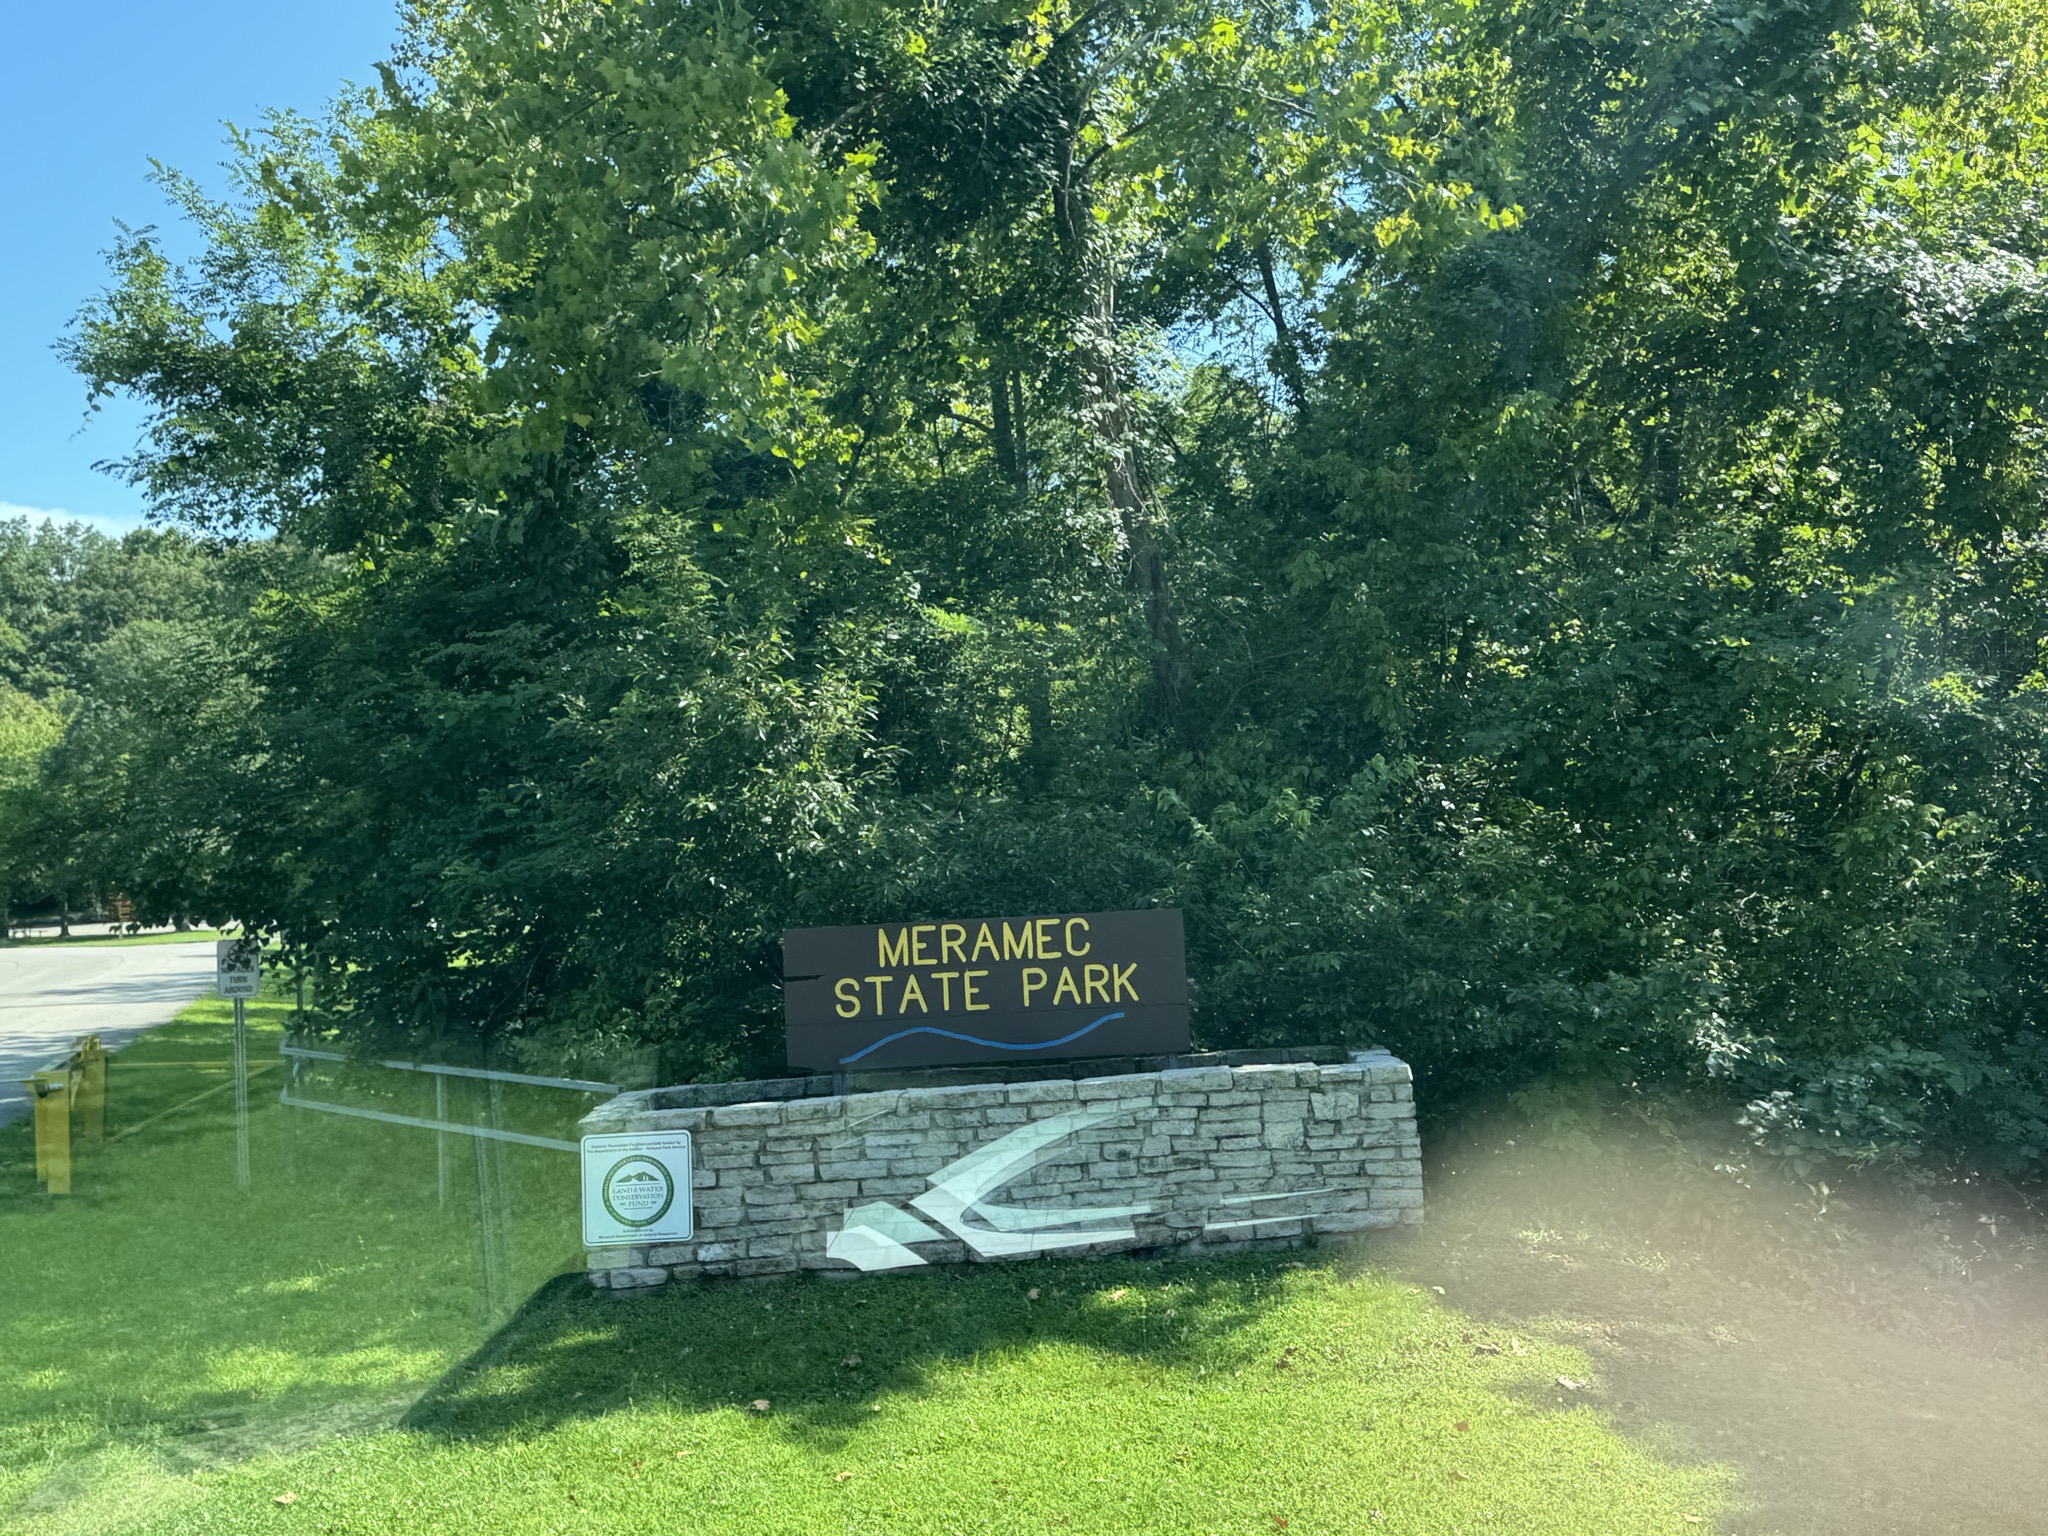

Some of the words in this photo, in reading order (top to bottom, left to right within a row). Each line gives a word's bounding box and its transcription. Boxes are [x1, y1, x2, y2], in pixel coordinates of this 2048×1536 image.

[878, 917, 1091, 969] MERAMEC
[229, 976, 248, 984] TURN
[224, 985, 253, 994] AROUND
[833, 969, 990, 1019] STATE
[1021, 962, 1140, 1008] PARK
[612, 1193, 664, 1201] CONSERVATION
